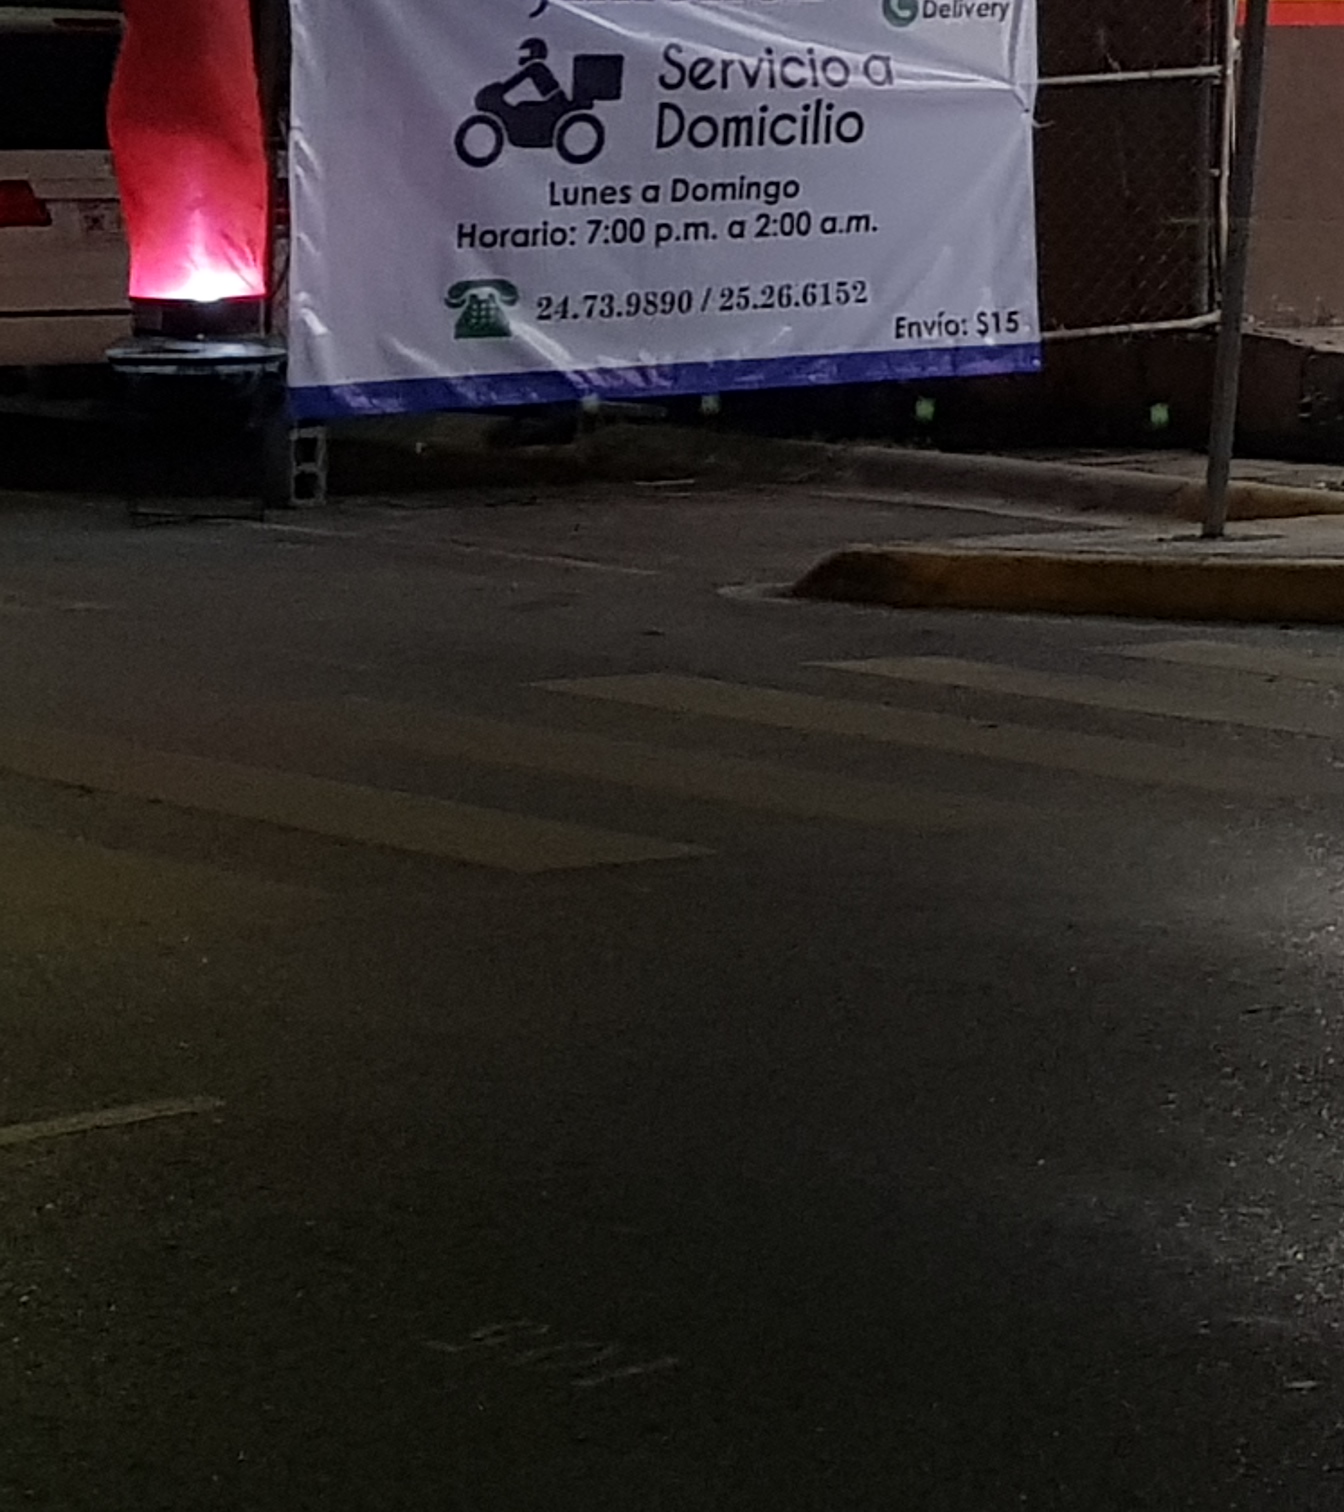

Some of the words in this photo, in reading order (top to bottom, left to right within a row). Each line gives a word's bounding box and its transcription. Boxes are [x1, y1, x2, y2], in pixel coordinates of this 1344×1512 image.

[658, 43, 850, 90] Servicio
[863, 53, 894, 87] a
[656, 98, 864, 149] Domicilio
[549, 180, 632, 207] Lunes
[641, 183, 661, 204] a
[671, 176, 800, 206] Domingo
[457, 221, 577, 249] Horario:
[586, 217, 646, 245] 7:00
[655, 222, 718, 248] p.m.
[727, 218, 746, 239] a
[755, 211, 811, 237] 2:00
[820, 212, 879, 236] a.m.
[536, 290, 693, 322] 24.73.9890
[700, 288, 710, 314] /
[719, 280, 869, 312] 25.26.6152
[895, 313, 968, 339] Envío:
[975, 310, 1020, 337] $15
